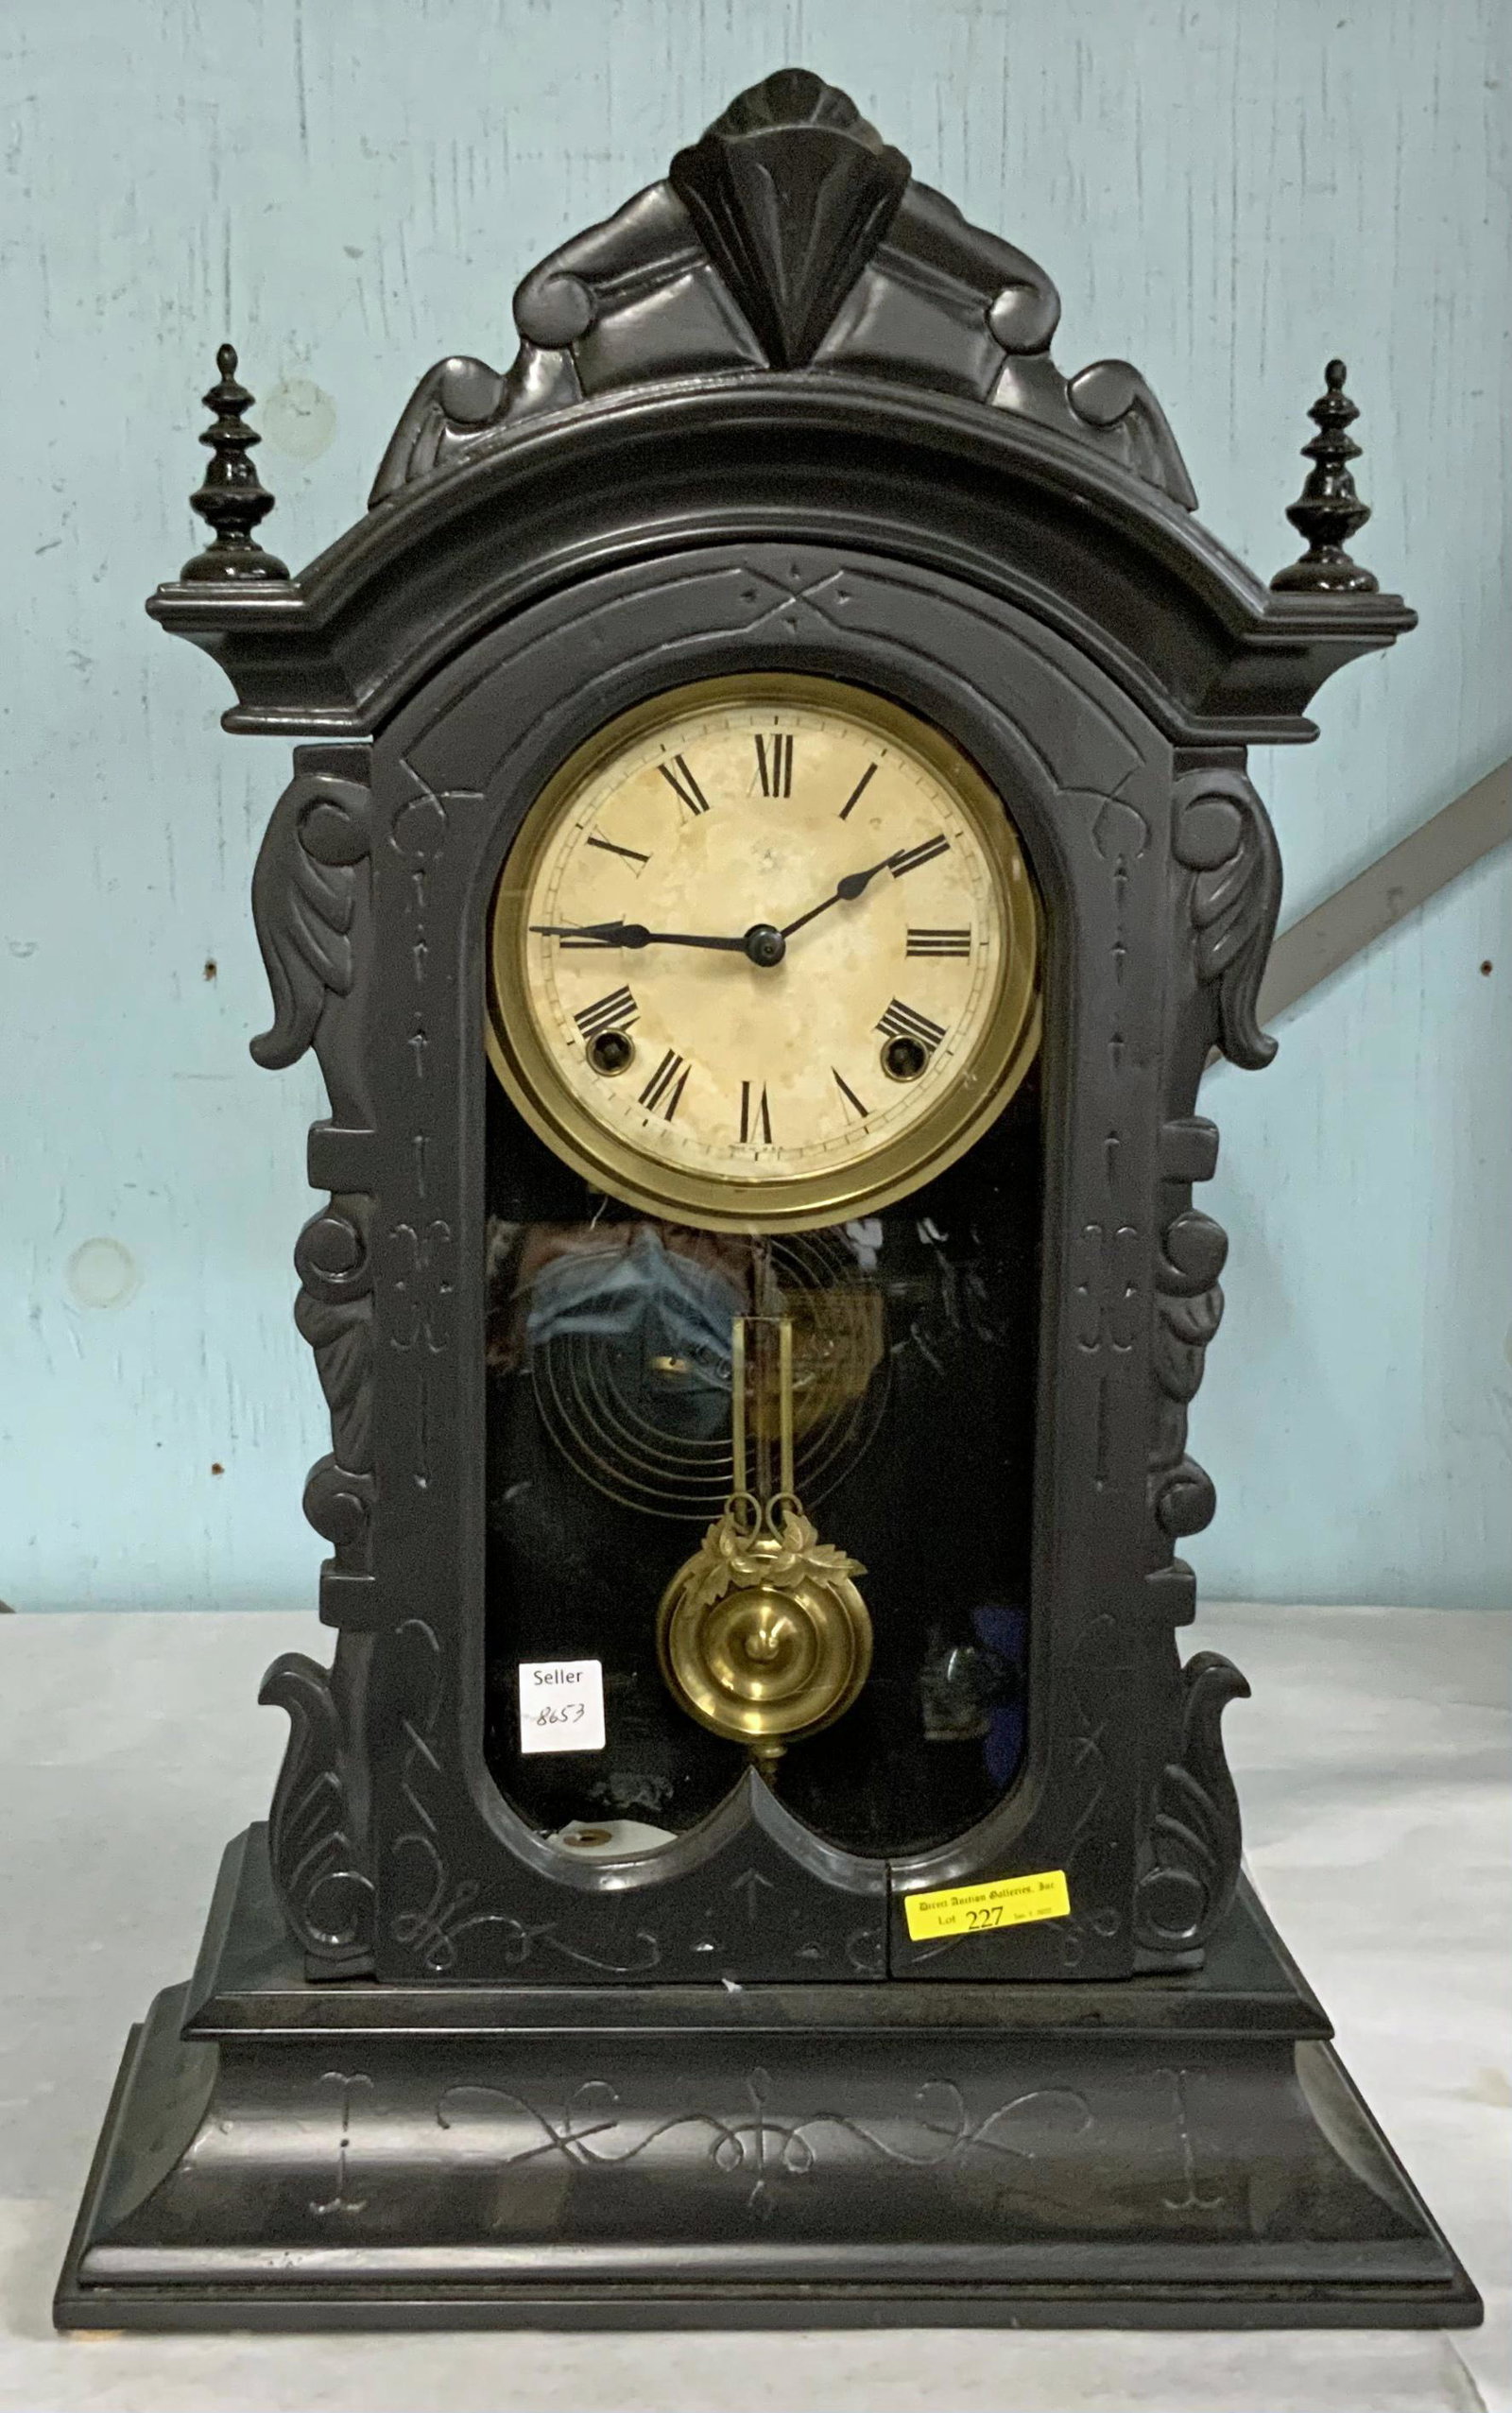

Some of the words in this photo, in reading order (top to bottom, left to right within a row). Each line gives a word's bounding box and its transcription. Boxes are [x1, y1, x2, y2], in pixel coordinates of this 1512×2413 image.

[747, 733, 794, 799] XII
[838, 762, 878, 820] I
[586, 825, 653, 878] X
[886, 833, 951, 879] II
[905, 923, 972, 963] III
[740, 1080, 773, 1144] VI
[831, 1065, 868, 1126] V
[534, 1669, 583, 1685] Seller
[537, 1703, 584, 1726] 8653
[938, 1915, 955, 1925] Lot
[966, 1906, 1004, 1929] 227
[951, 1893, 987, 1905] Auction
